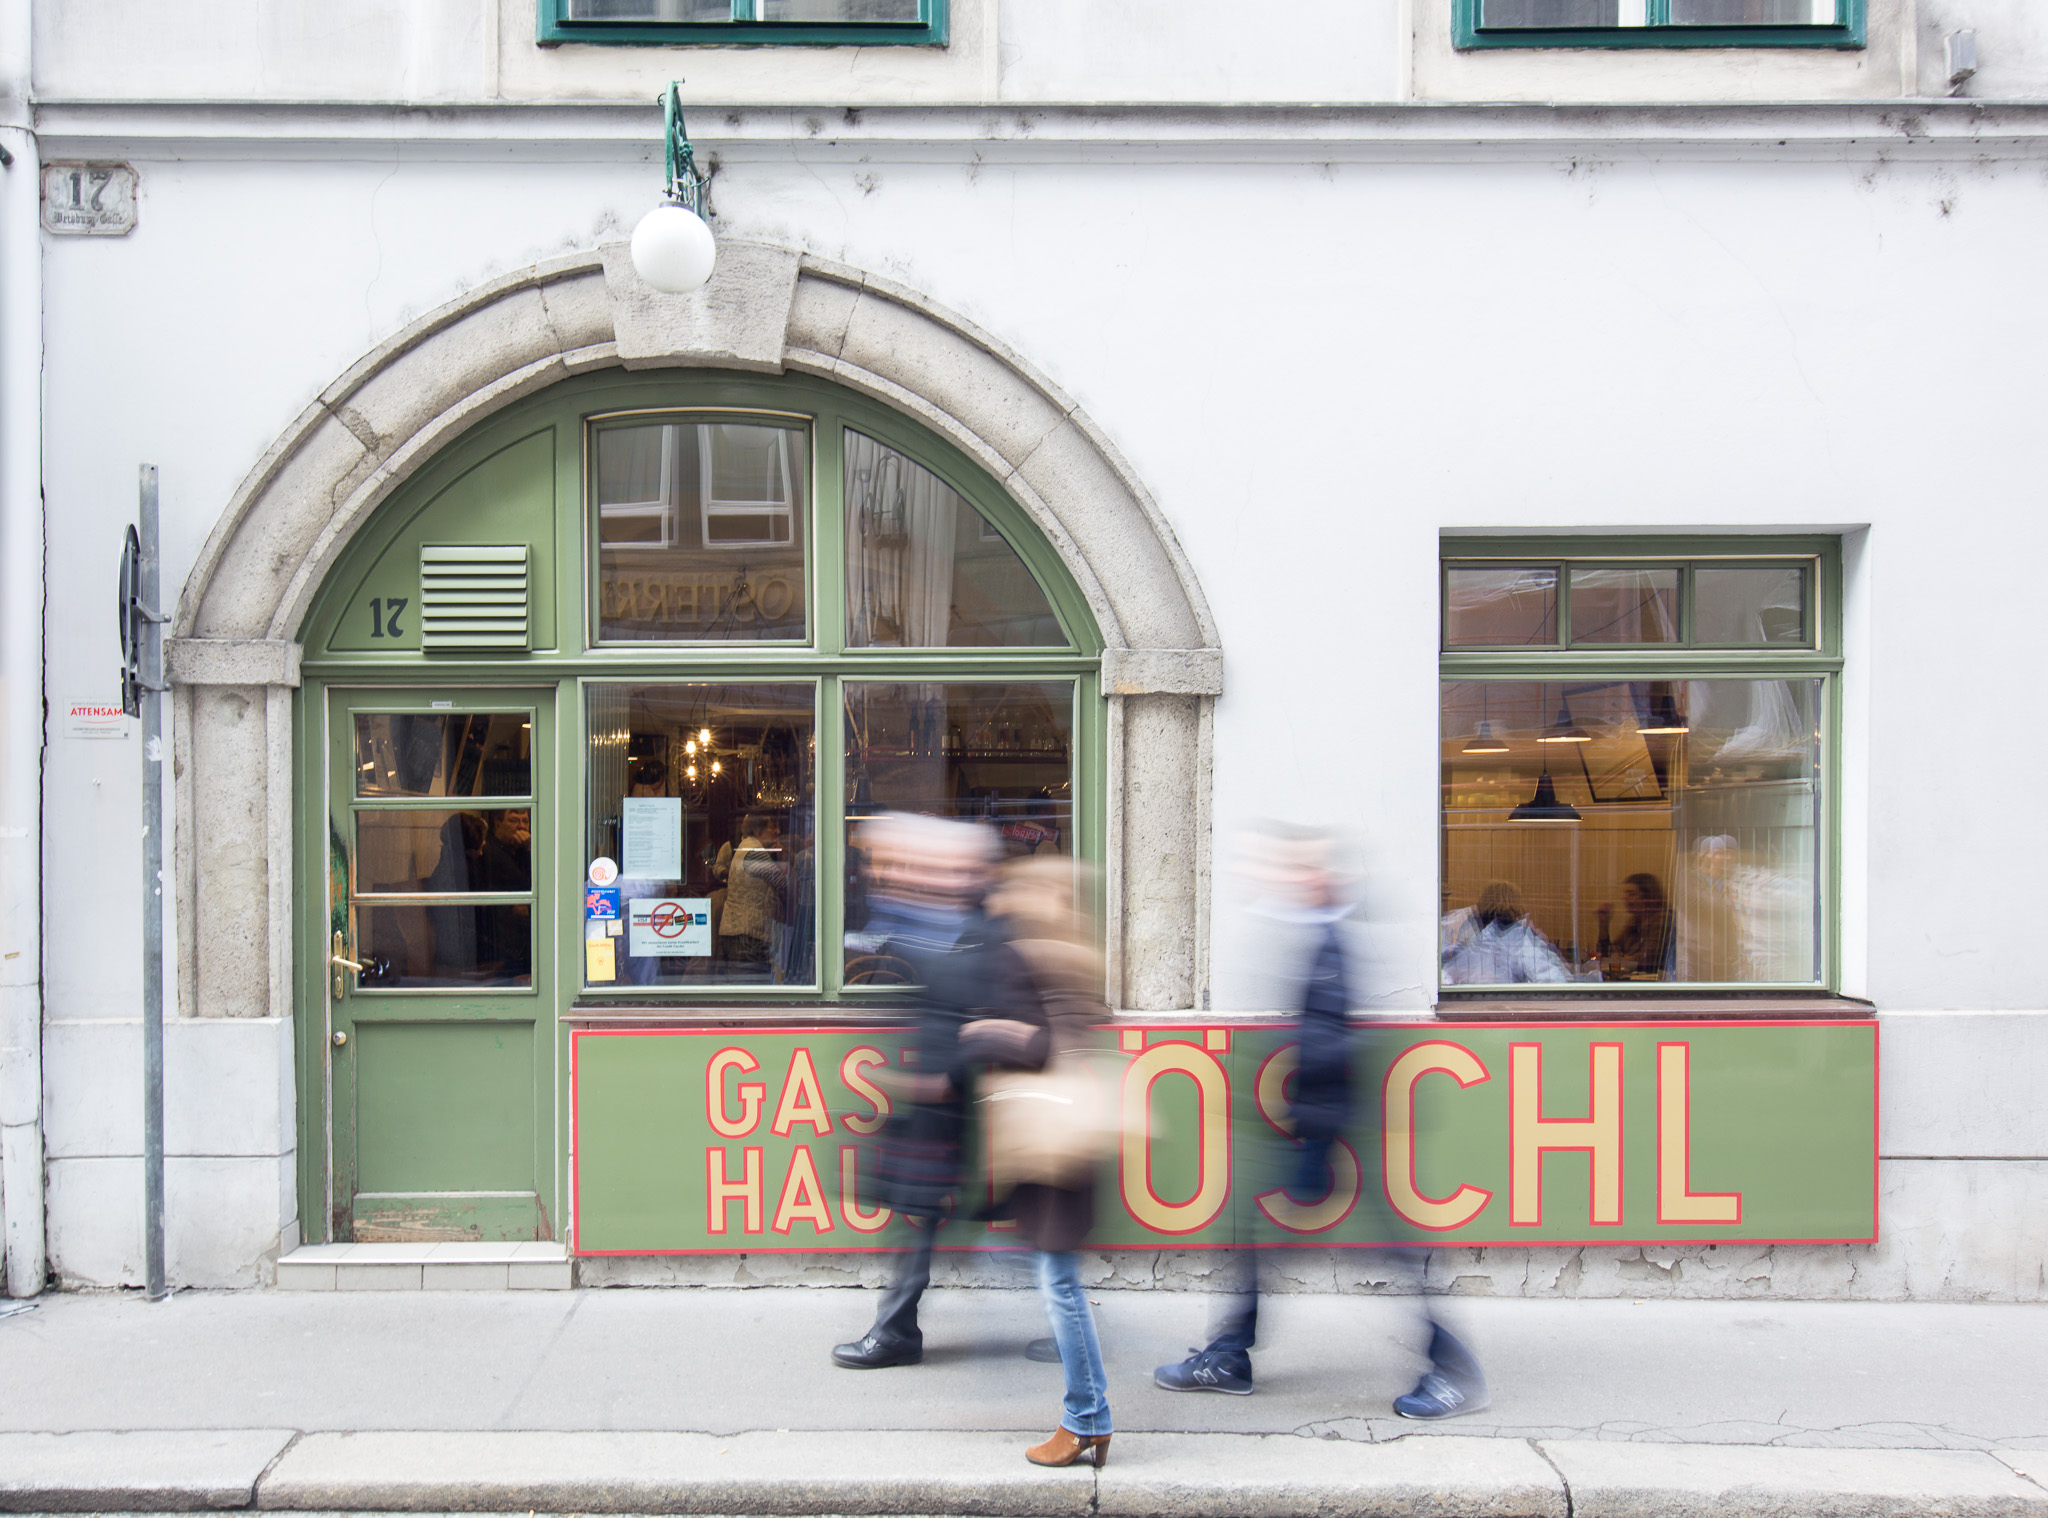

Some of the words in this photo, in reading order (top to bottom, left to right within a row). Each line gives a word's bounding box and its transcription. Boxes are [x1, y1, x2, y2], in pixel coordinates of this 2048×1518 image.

[69, 169, 114, 212] 17
[369, 597, 409, 638] 17
[70, 707, 122, 717] ATTENSAM
[705, 1044, 922, 1140] GAS
